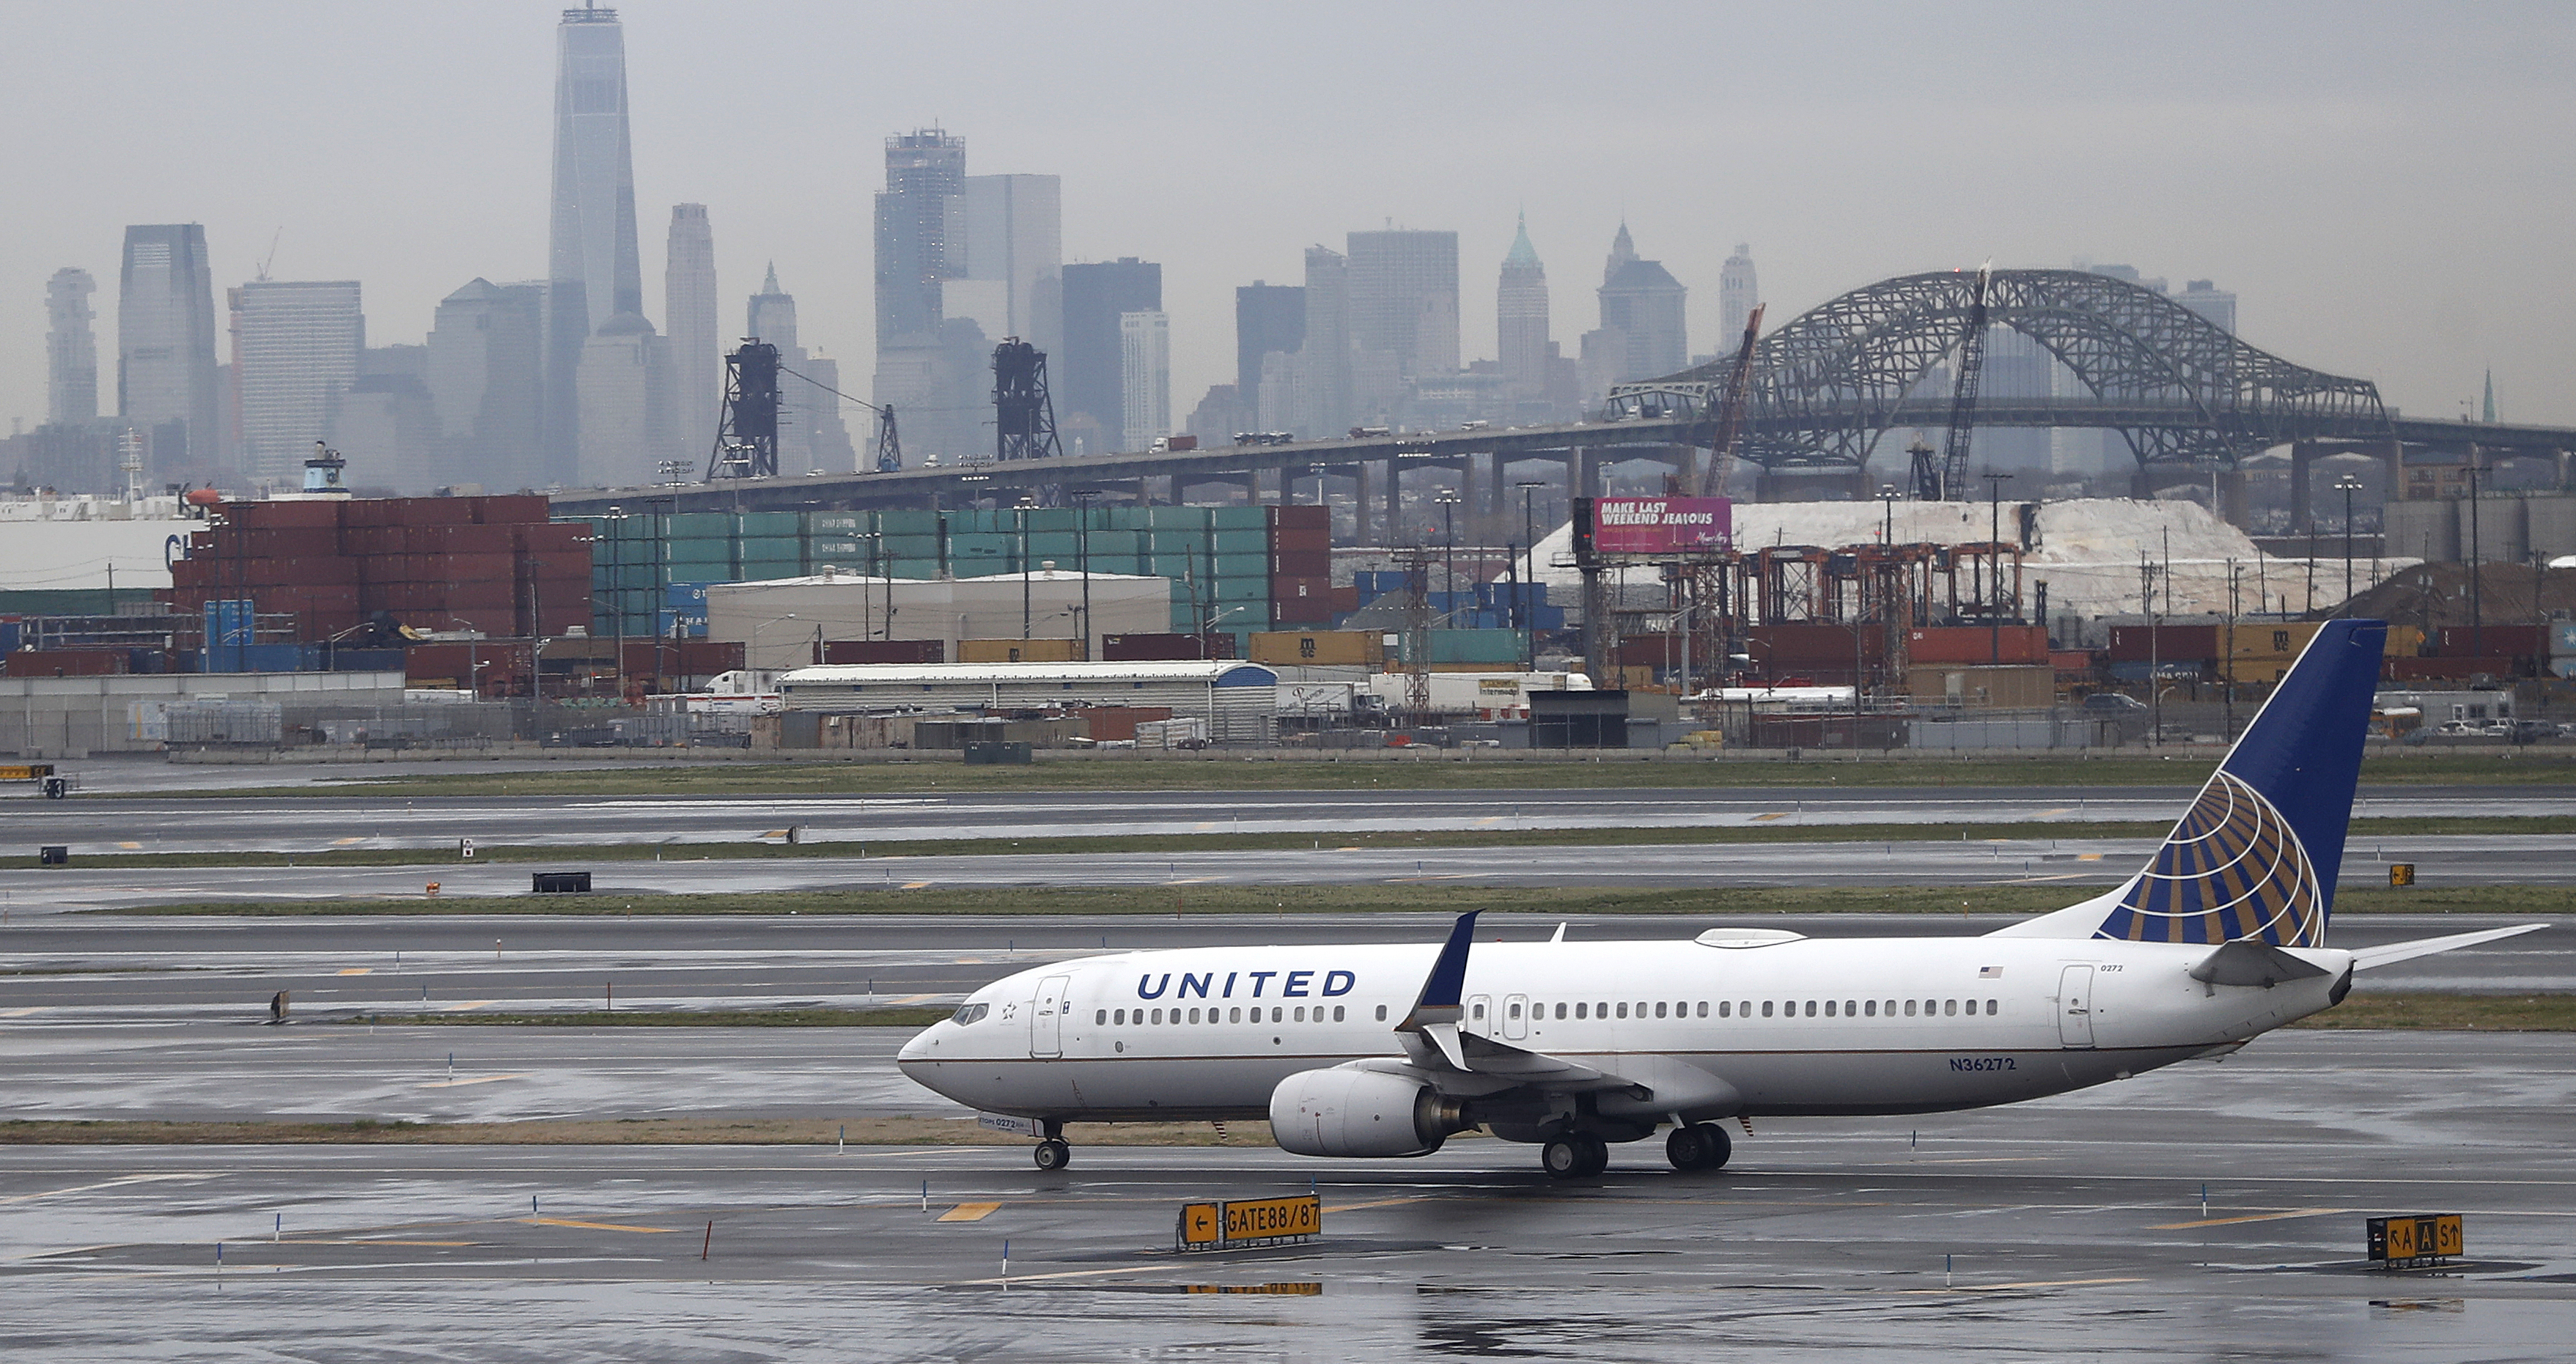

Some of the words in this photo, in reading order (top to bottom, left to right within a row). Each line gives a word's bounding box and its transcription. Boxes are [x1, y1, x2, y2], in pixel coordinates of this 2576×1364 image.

[1601, 502, 1635, 514] MAKE
[1639, 502, 1668, 514] LAST
[1602, 514, 1658, 526] WEEKEND
[1662, 513, 1713, 525] JEALOUS
[1137, 970, 1355, 1000] UNITED
[1949, 1058, 2016, 1071] N36272
[996, 1118, 1016, 1128] 0272
[2402, 1226, 2413, 1250] A
[2421, 1225, 2431, 1249] A
[2440, 1224, 2448, 1247] S
